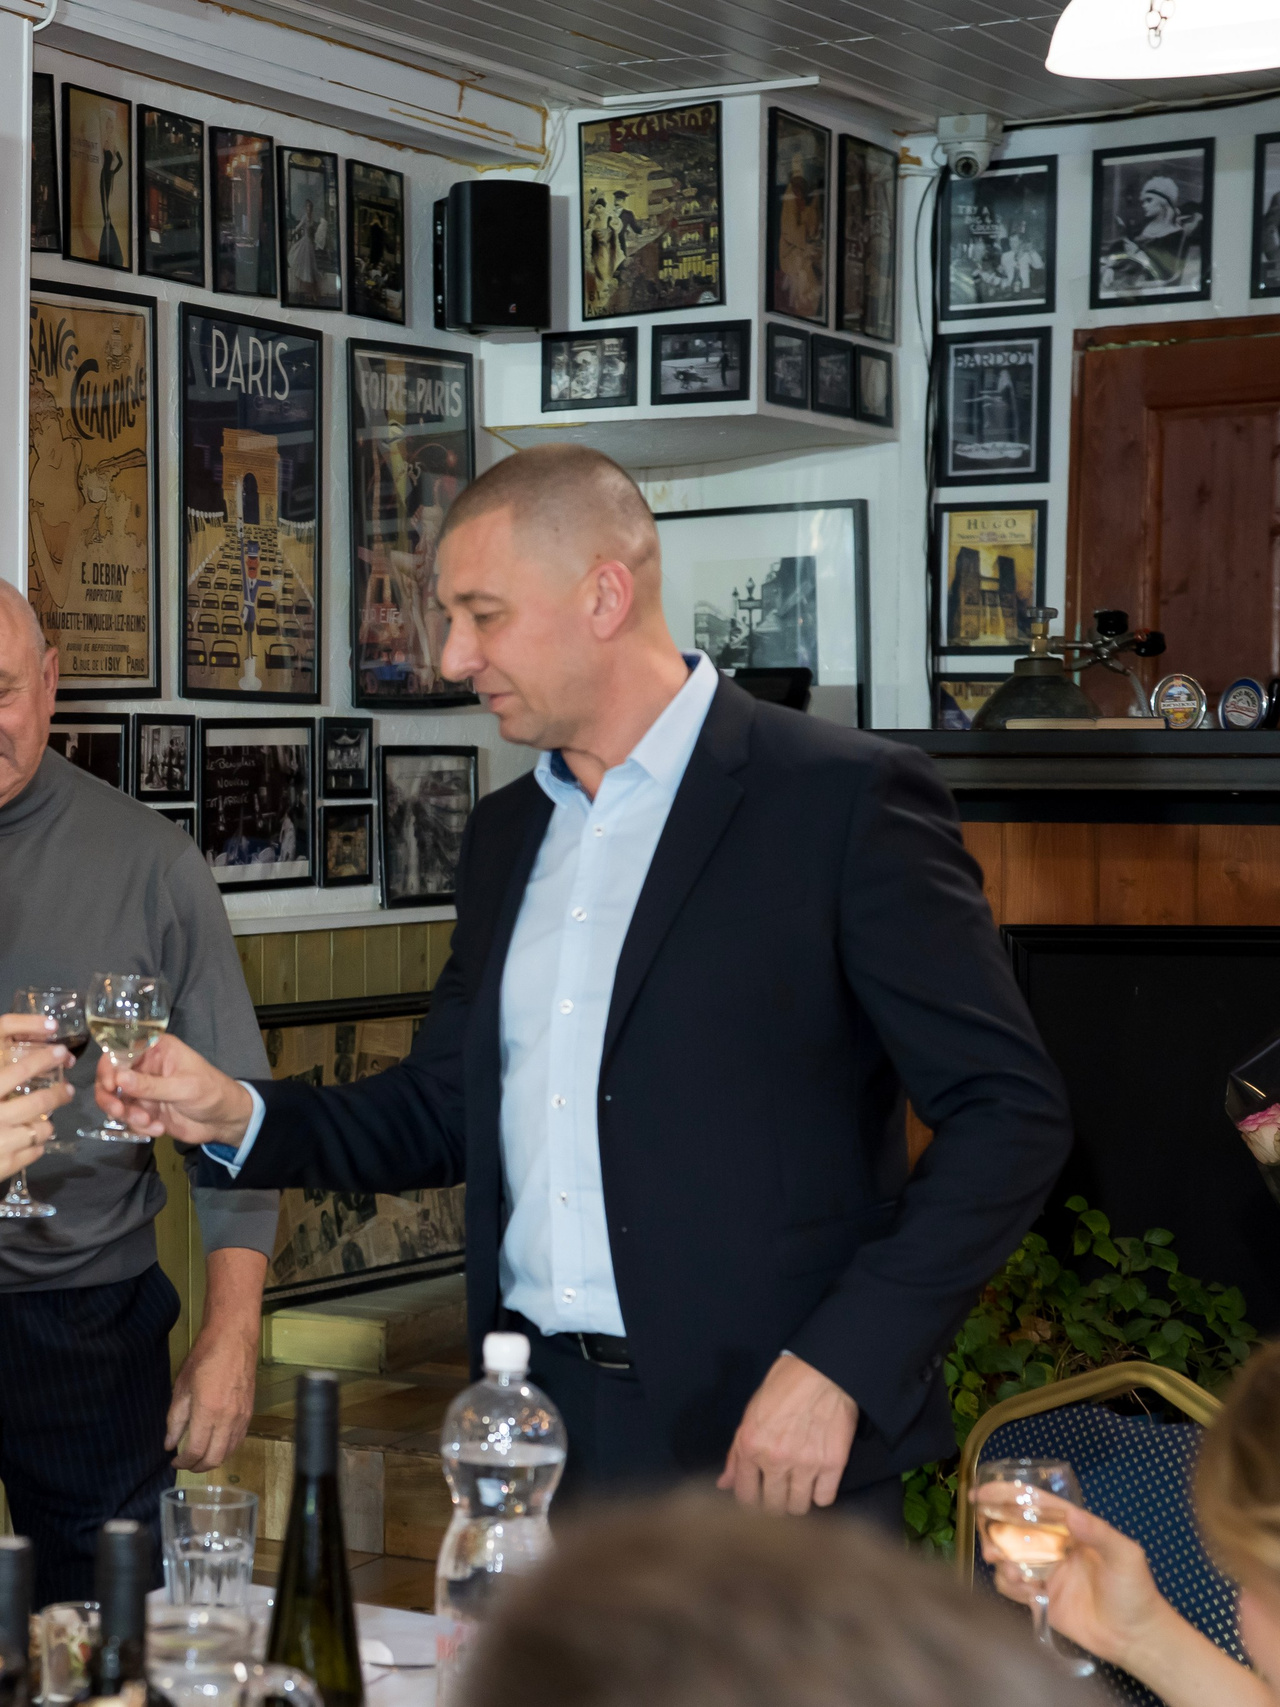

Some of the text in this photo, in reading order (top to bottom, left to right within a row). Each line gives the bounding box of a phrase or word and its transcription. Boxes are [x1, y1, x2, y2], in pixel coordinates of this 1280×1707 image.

[212, 328, 290, 401] PARIS
[955, 350, 1036, 369] BARDOT
[71, 358, 146, 443] CHAMPAGNE
[360, 370, 407, 411] FOIRE
[967, 518, 1017, 530] HUGO
[81, 562, 129, 586] E. DEBRAY
[92, 659, 99, 671] DE
[126, 655, 145, 673] PARIS
